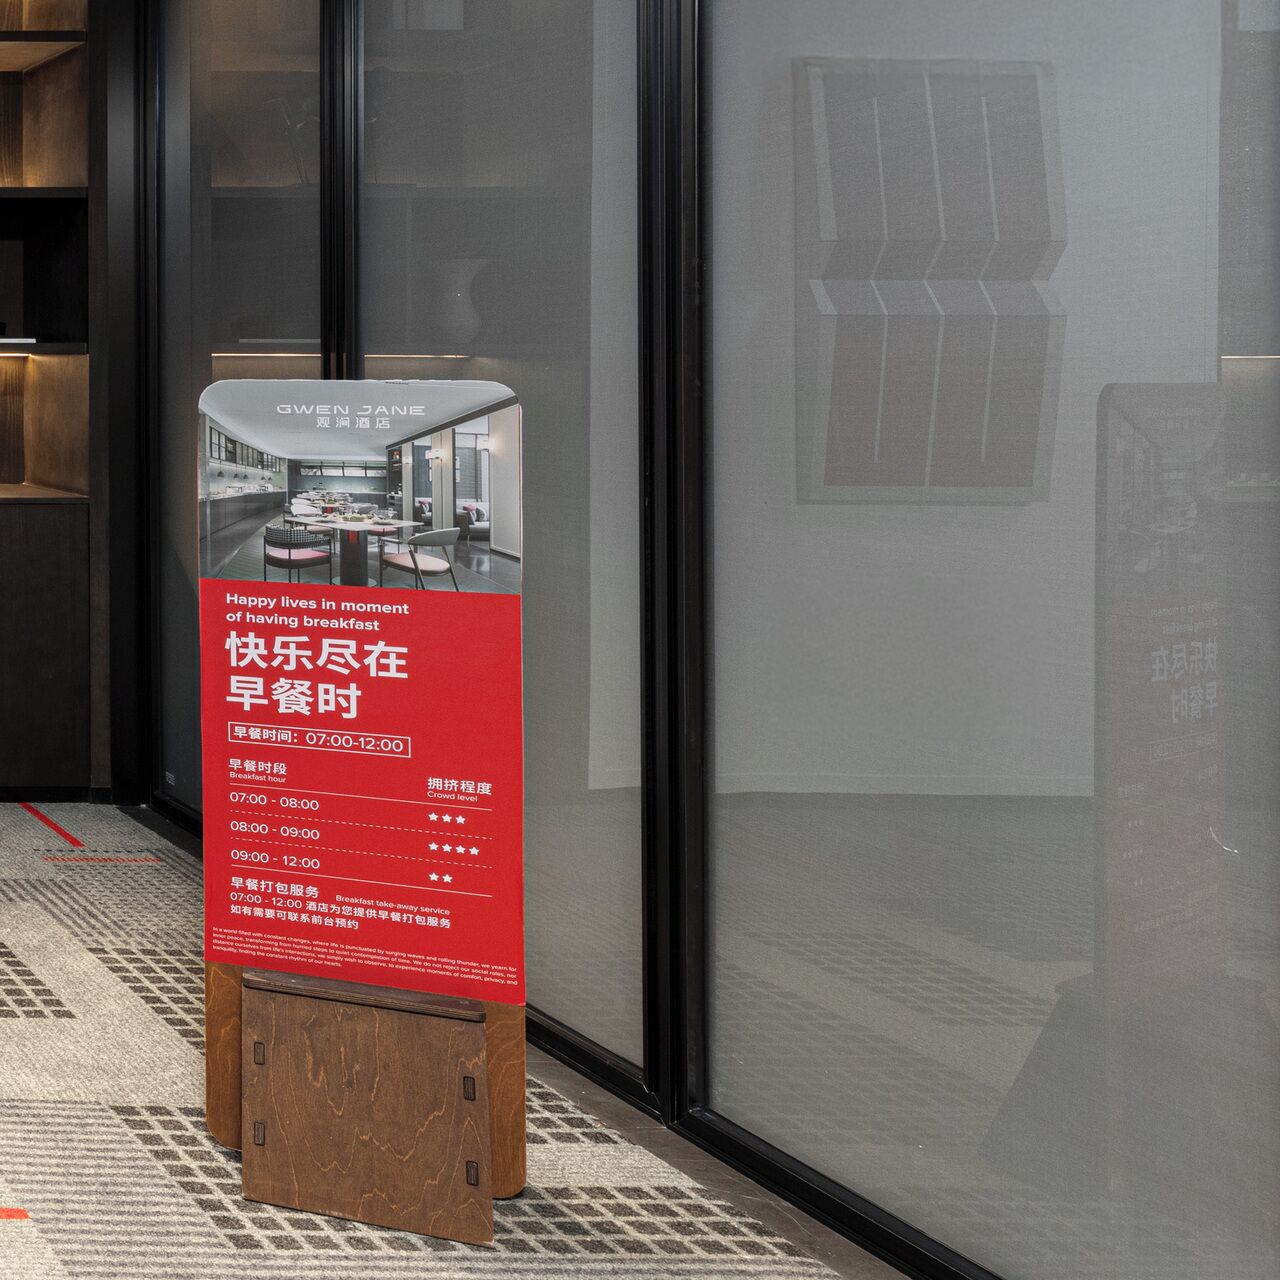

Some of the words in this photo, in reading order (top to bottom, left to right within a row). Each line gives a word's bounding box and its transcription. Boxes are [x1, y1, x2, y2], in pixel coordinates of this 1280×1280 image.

[276, 403, 348, 415] GWEN
[356, 404, 425, 416] JANE
[316, 415, 391, 430] 观涧酒店
[226, 593, 277, 609] Happy
[281, 596, 317, 609] lives
[322, 598, 336, 610] in
[341, 602, 409, 614] moment
[226, 611, 242, 622] of
[246, 612, 298, 628] having
[304, 615, 379, 631] breakfast
[224, 630, 409, 679] 快乐尽在
[225, 674, 362, 720] 早餐时
[233, 726, 298, 744] 早餐时间：
[305, 732, 404, 752] 07:00-12:00
[228, 758, 288, 776] 早餐时段
[229, 771, 266, 782] Breakfast
[268, 775, 286, 783] hour
[427, 776, 492, 795] 拥挤程度
[230, 792, 267, 805] 07:00
[280, 797, 319, 810] 08:00
[427, 790, 455, 800] Crowd
[457, 793, 478, 802] level
[230, 821, 269, 834] 08:00
[280, 826, 320, 840] 09:00
[231, 849, 269, 863] 09:00
[283, 856, 320, 869] 12:00
[230, 876, 319, 899] 早餐打包服务
[230, 891, 262, 905] 07:00
[271, 897, 302, 909] 12:00
[305, 900, 451, 929] 酒店为您提供早餐打包服务
[336, 895, 374, 905] Breakfast
[376, 900, 418, 912] take-away
[420, 907, 450, 915] service
[230, 904, 359, 930] 如有需要可联系前台预约
[213, 939, 234, 948] distance
[285, 949, 317, 957] interactions,
[395, 964, 425, 972] experience
[238, 948, 256, 956] finding
[245, 937, 278, 946] transforming
[351, 952, 390, 961] contemplation
[345, 945, 376, 953] punctuated
